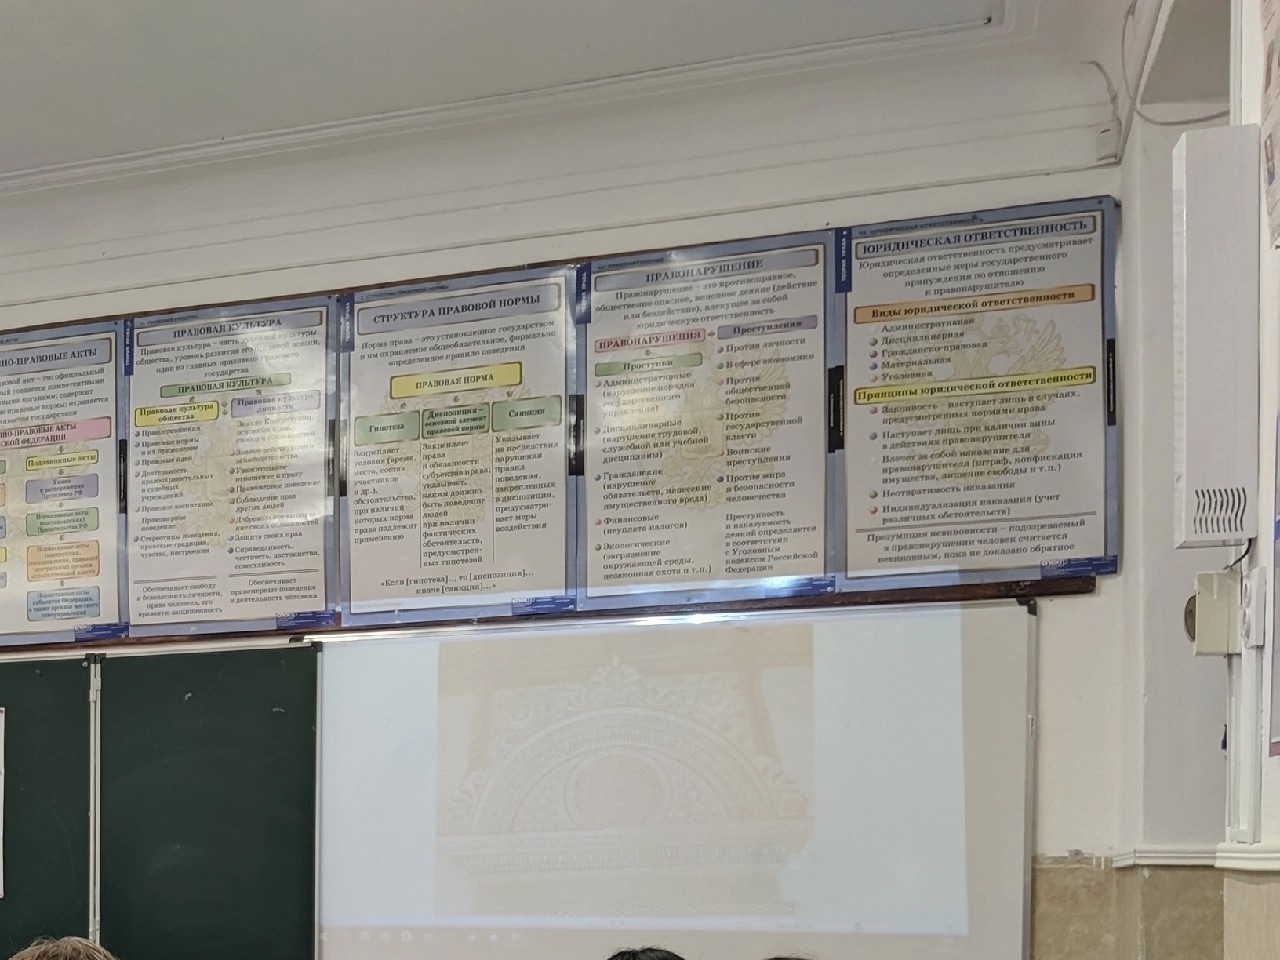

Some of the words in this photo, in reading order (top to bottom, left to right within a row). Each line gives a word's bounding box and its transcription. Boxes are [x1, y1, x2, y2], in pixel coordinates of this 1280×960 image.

[863, 234, 960, 255] ЮРИДИЧЕСКАЯ
[964, 220, 1086, 242] ОТВЕТСТВЕННОСТЬ
[646, 259, 763, 282] ПРАВОНАРУШЕНИЕ
[373, 308, 435, 324] СТРУКТУРА
[438, 299, 495, 316] ПРАВОВОЙ
[499, 294, 539, 307] НОРМЫ
[871, 307, 901, 319] Виды
[903, 300, 977, 316] юридической
[980, 291, 1074, 307] ответственности
[173, 324, 226, 338] ПРАВОВАЯ
[598, 331, 701, 349] ПРАВОНАРУШЕНИЯ
[70, 348, 96, 358] АКТЫ
[178, 382, 223, 393] ПРАВОВАЯ
[416, 377, 461, 389] ПРАВОВАЯ
[464, 373, 493, 384] НОРМА
[858, 387, 918, 401] Принципы
[920, 380, 994, 395] юридической
[997, 371, 1091, 388] ответственности
